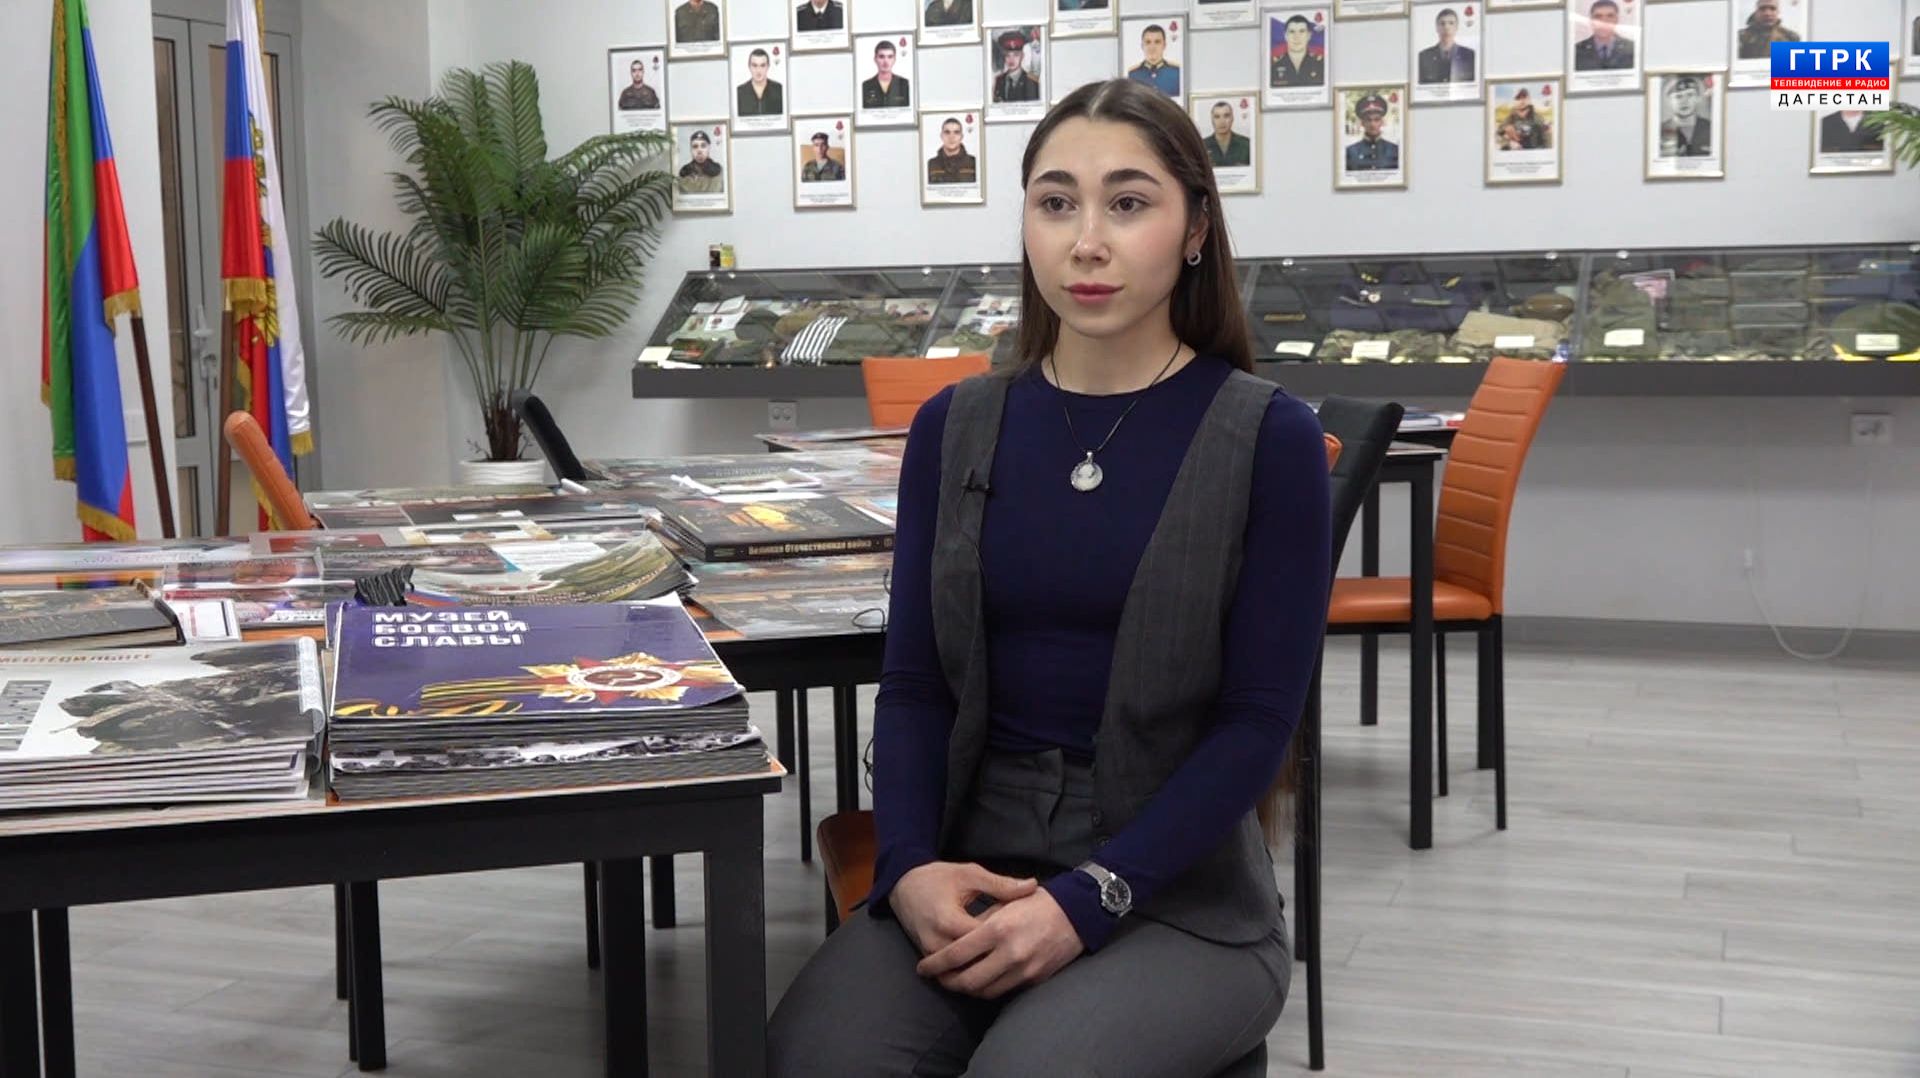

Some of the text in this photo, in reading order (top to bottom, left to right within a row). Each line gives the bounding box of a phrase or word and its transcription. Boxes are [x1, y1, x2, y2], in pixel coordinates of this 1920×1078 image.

[375, 610, 509, 623] МУЗЕЙ
[375, 621, 527, 634] БОЕВОЙ
[374, 634, 522, 647] СЛАВЫ
